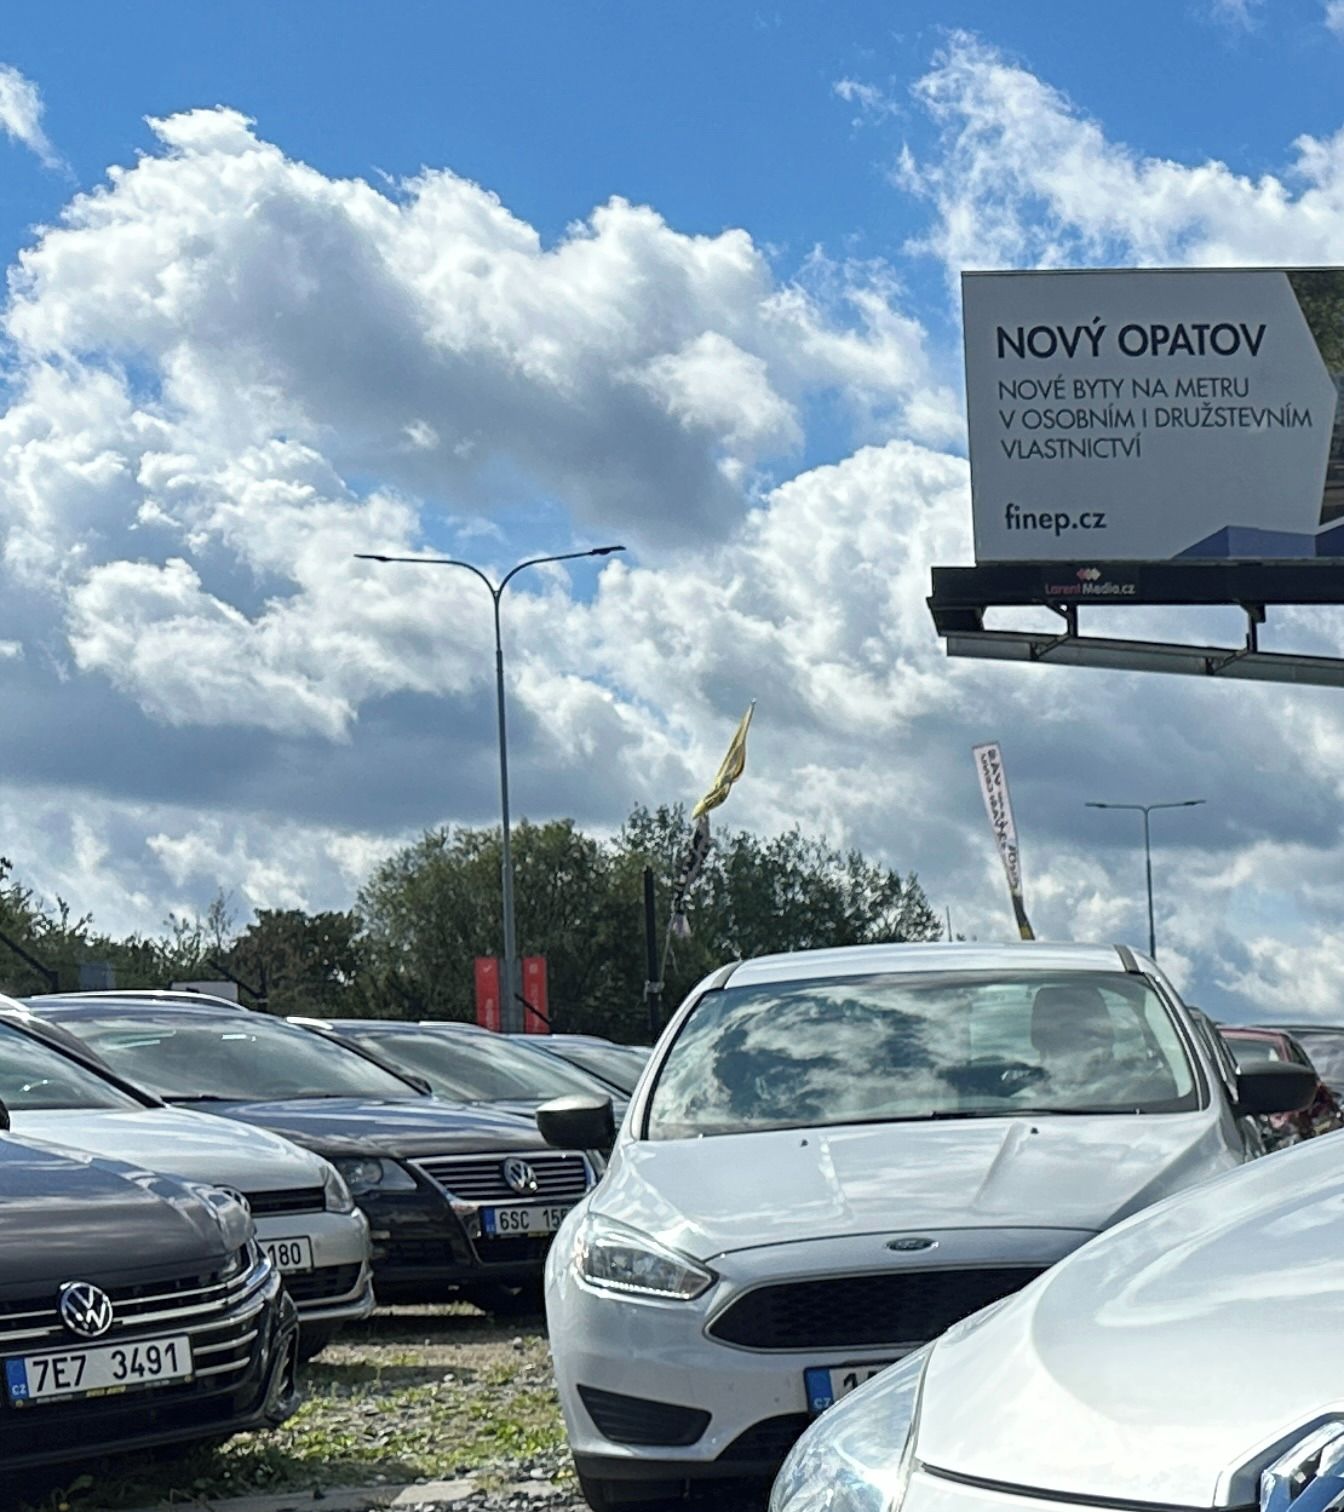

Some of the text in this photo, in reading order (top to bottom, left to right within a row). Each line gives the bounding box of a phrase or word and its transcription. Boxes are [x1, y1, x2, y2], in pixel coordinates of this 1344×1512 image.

[997, 316, 1266, 358] NOVÝ OPATOV
[998, 374, 1249, 400] NOVÉ BYTY NA METRU
[999, 410, 1015, 429] V
[1022, 403, 1135, 429] OSOBNÍM
[1155, 402, 1313, 428] DRUŽSTEVNÍM
[1001, 433, 1142, 459] VLASTNICTVÍ
[1005, 502, 1107, 536] finep.cz
[500, 1210, 529, 1230] 6SC
[32, 1342, 178, 1392] 7E7 3491
